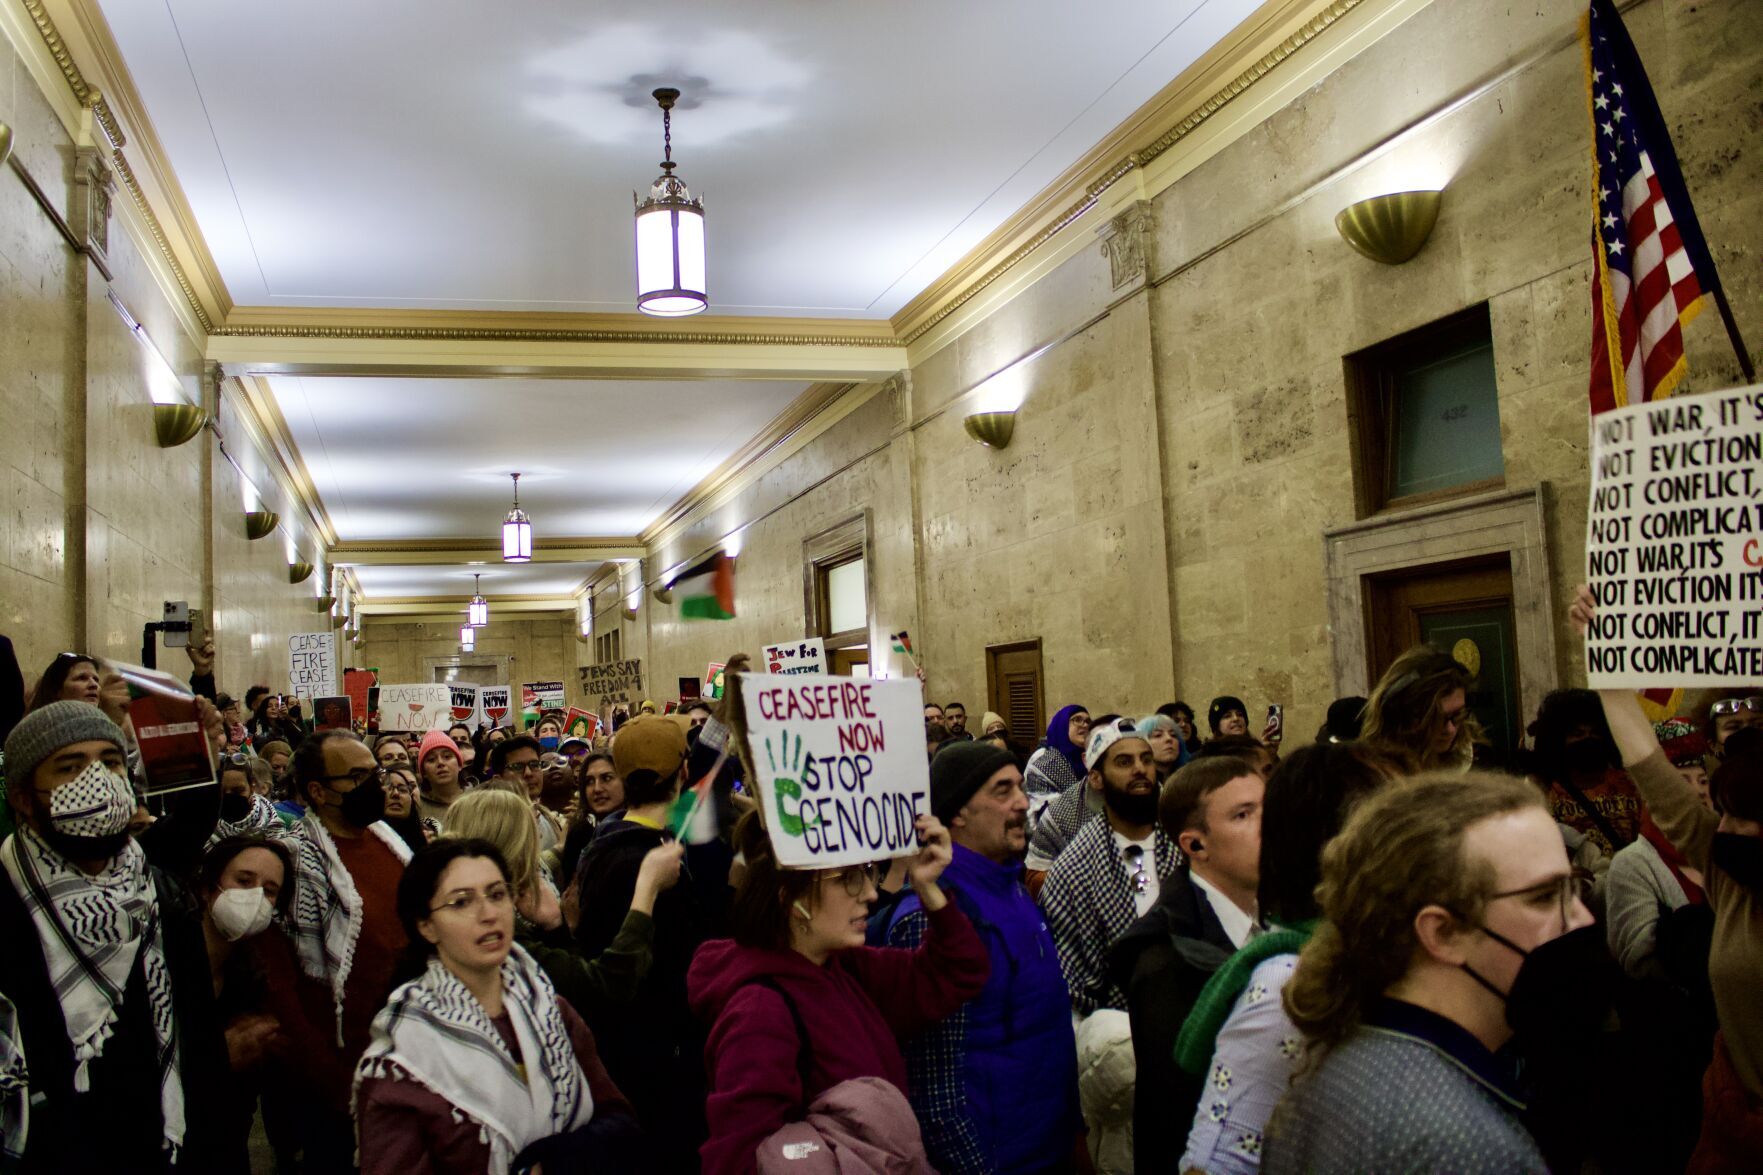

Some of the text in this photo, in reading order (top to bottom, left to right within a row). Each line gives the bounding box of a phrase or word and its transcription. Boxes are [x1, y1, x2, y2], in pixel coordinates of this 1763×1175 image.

[1600, 415, 1635, 446] NOT
[1648, 405, 1713, 437] WAR,
[1598, 449, 1635, 481] NOT
[1594, 468, 1761, 513] NOT CONFLICT,
[1592, 516, 1632, 544] NOT
[1590, 548, 1629, 577] NOT
[1590, 580, 1628, 607] NOT
[1634, 573, 1732, 605] EVICTION
[1588, 613, 1627, 641] NOT
[1632, 611, 1737, 645] CONFLICT,
[289, 634, 327, 652] CEASE
[292, 651, 328, 670] FIRE
[579, 659, 640, 680] JEWS SAY
[1588, 645, 1763, 676] NOT COMPLICATE
[289, 669, 328, 685] CEASE
[448, 686, 476, 695] EASEFIRE
[583, 676, 629, 696] FREEDOM
[296, 684, 329, 699] FIRE
[382, 687, 446, 703] CEASEFIRE
[483, 696, 508, 708] NOW
[601, 693, 629, 706] ALL
[759, 682, 877, 721] CEASEFIRE
[397, 711, 438, 729] NOW
[838, 720, 885, 754] NOW
[802, 754, 873, 793] STOP
[800, 791, 926, 855] GENOCIDE
